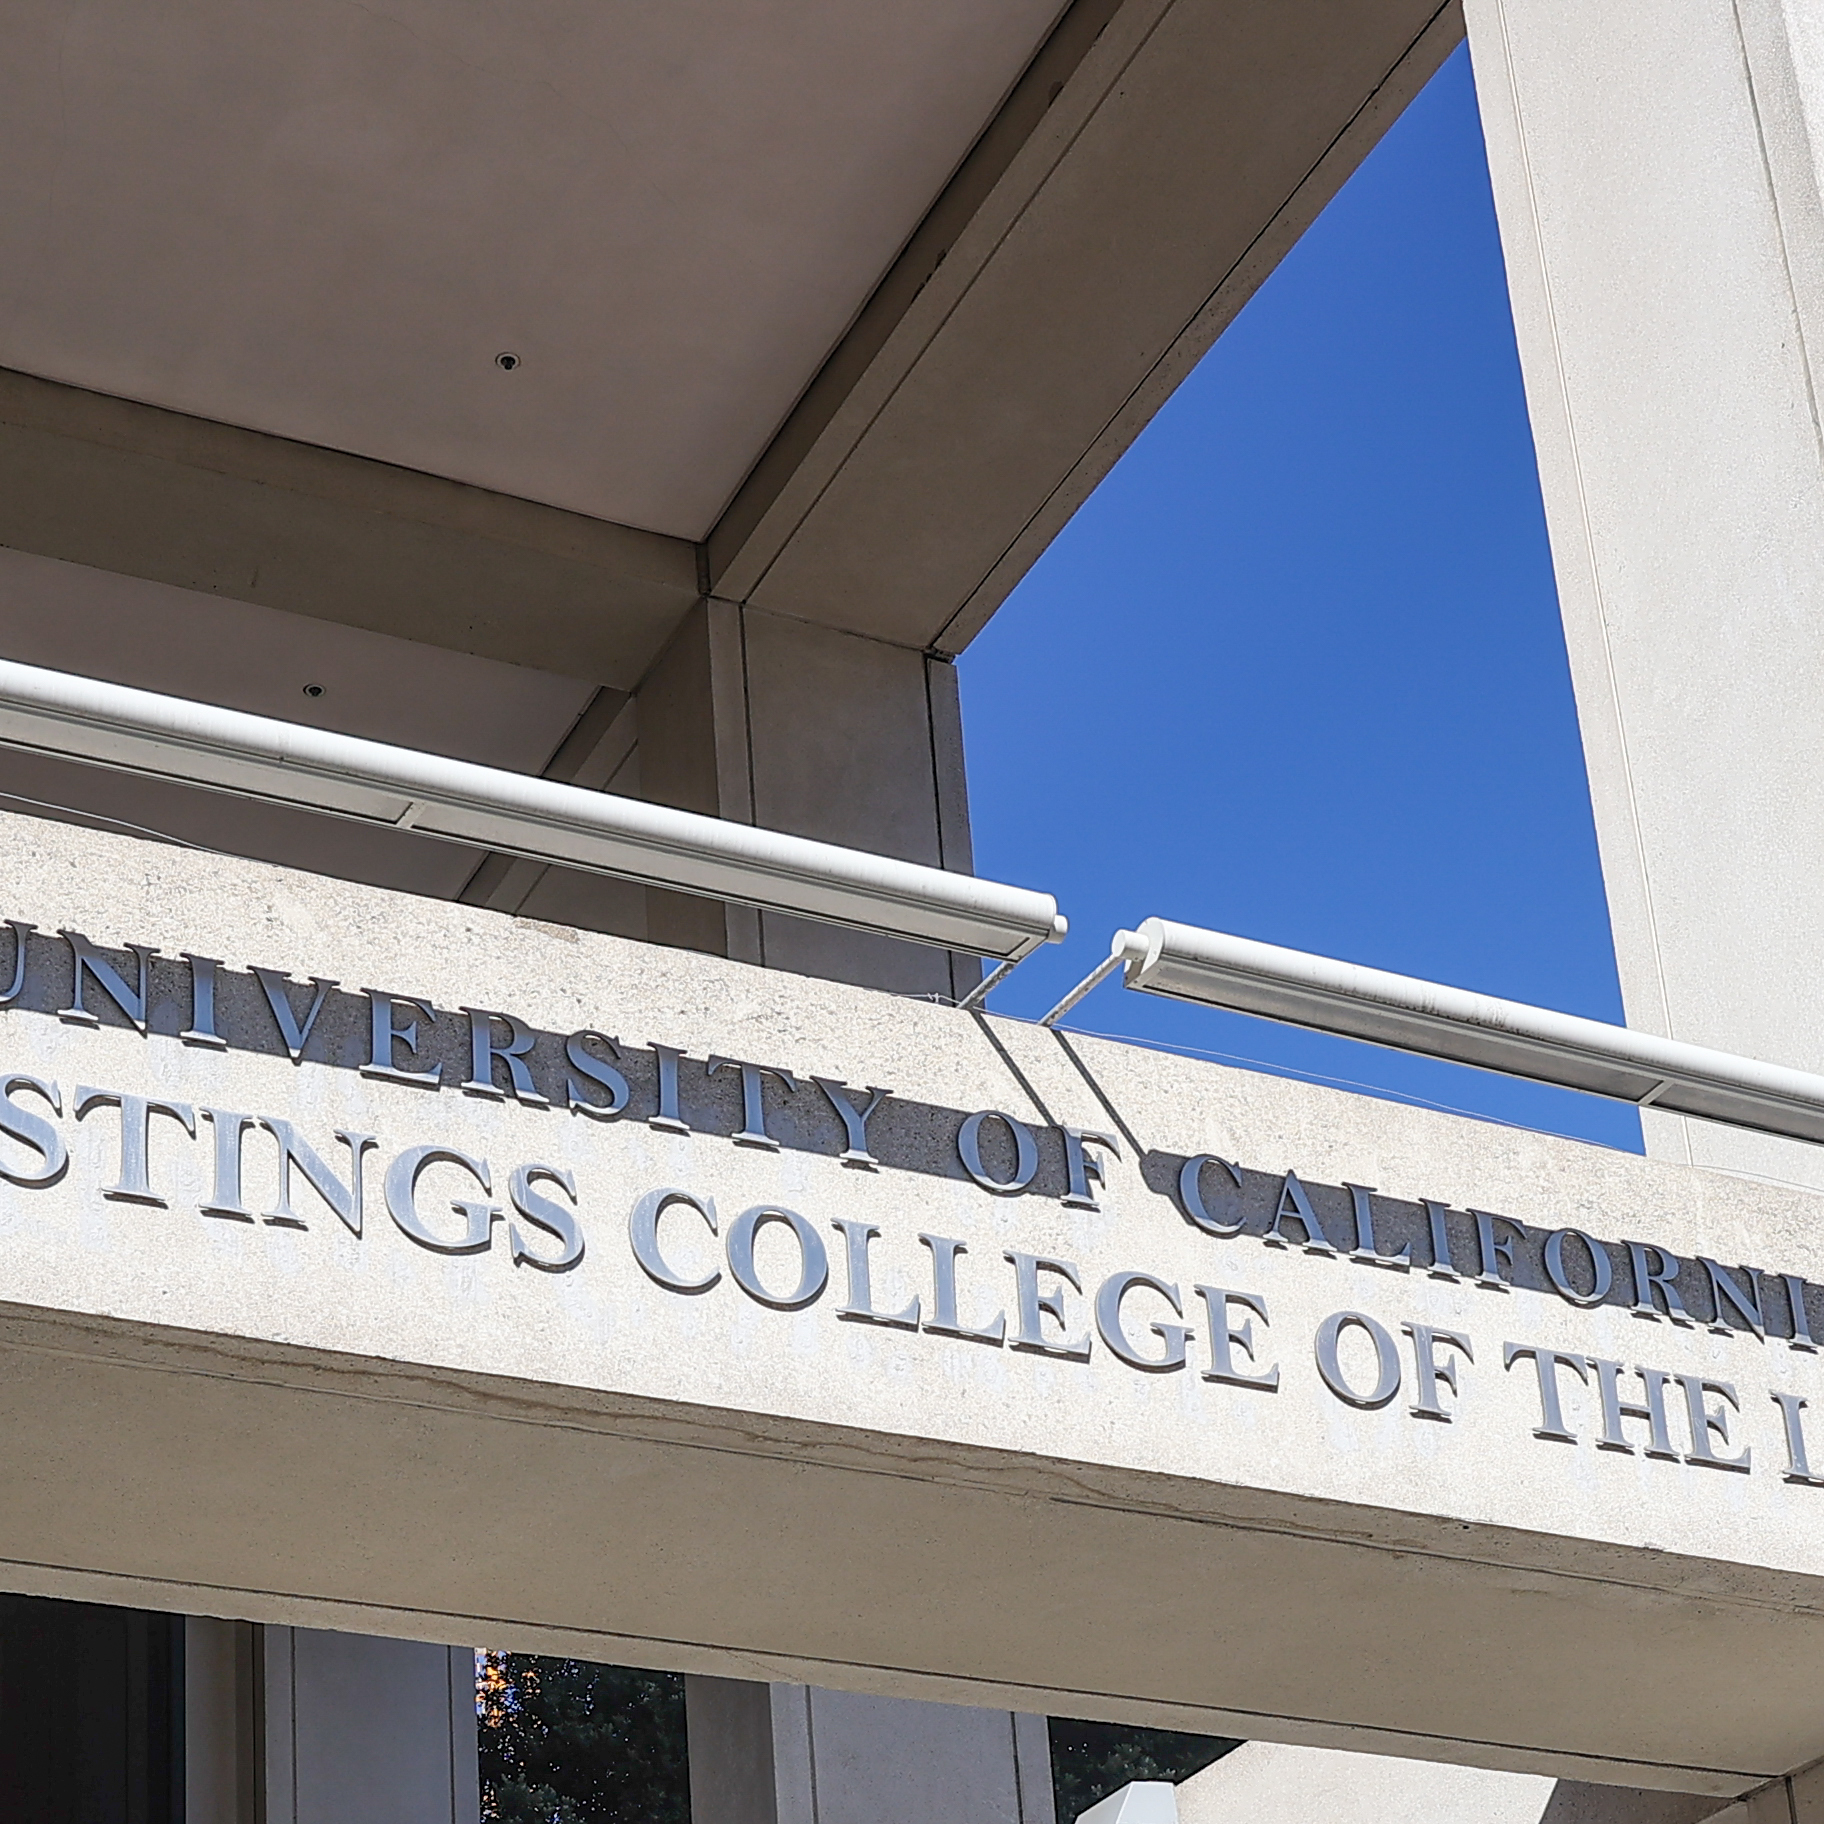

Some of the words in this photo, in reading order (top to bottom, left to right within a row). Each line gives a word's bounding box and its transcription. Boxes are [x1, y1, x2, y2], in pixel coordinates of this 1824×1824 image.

[958, 1110, 1121, 1210] OF
[629, 1187, 1279, 1392] COLLEGE
[1315, 1311, 1474, 1421] OF
[1504, 1341, 1752, 1473] THE
